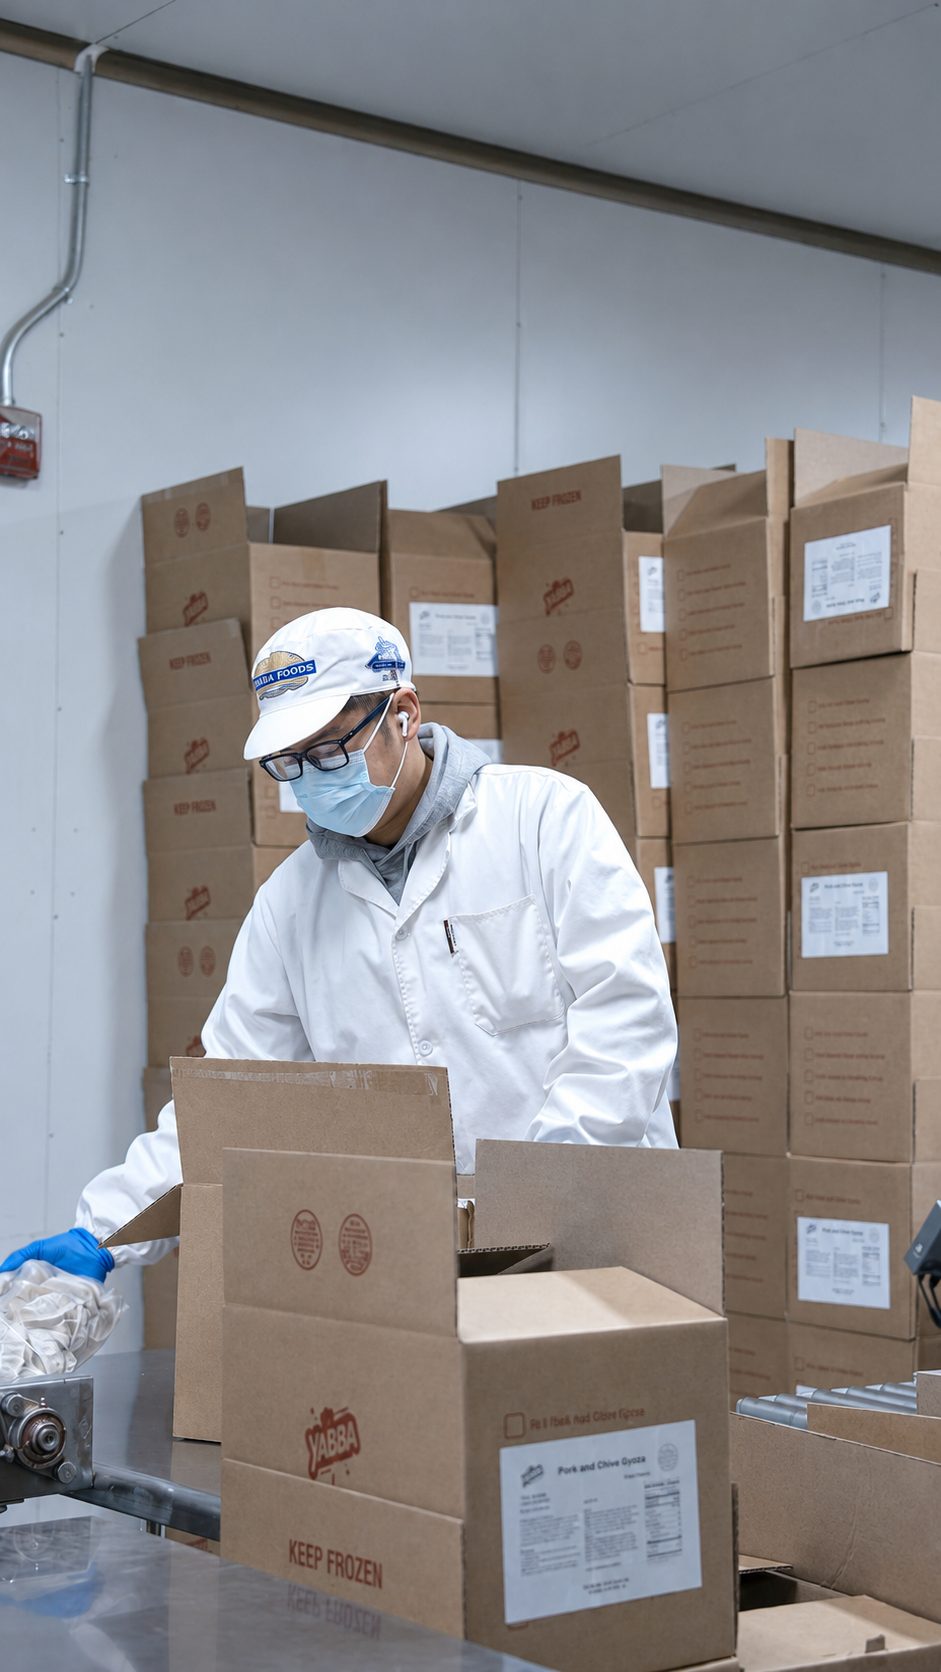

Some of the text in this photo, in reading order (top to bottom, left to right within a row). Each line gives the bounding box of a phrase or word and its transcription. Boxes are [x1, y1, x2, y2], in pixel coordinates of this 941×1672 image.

[277, 663, 314, 680] FOODS
[307, 1420, 358, 1472] YABBA
[558, 1456, 646, 1475] Pork and Chive Gyoza
[289, 1538, 382, 1589] KEEP FROZEN
